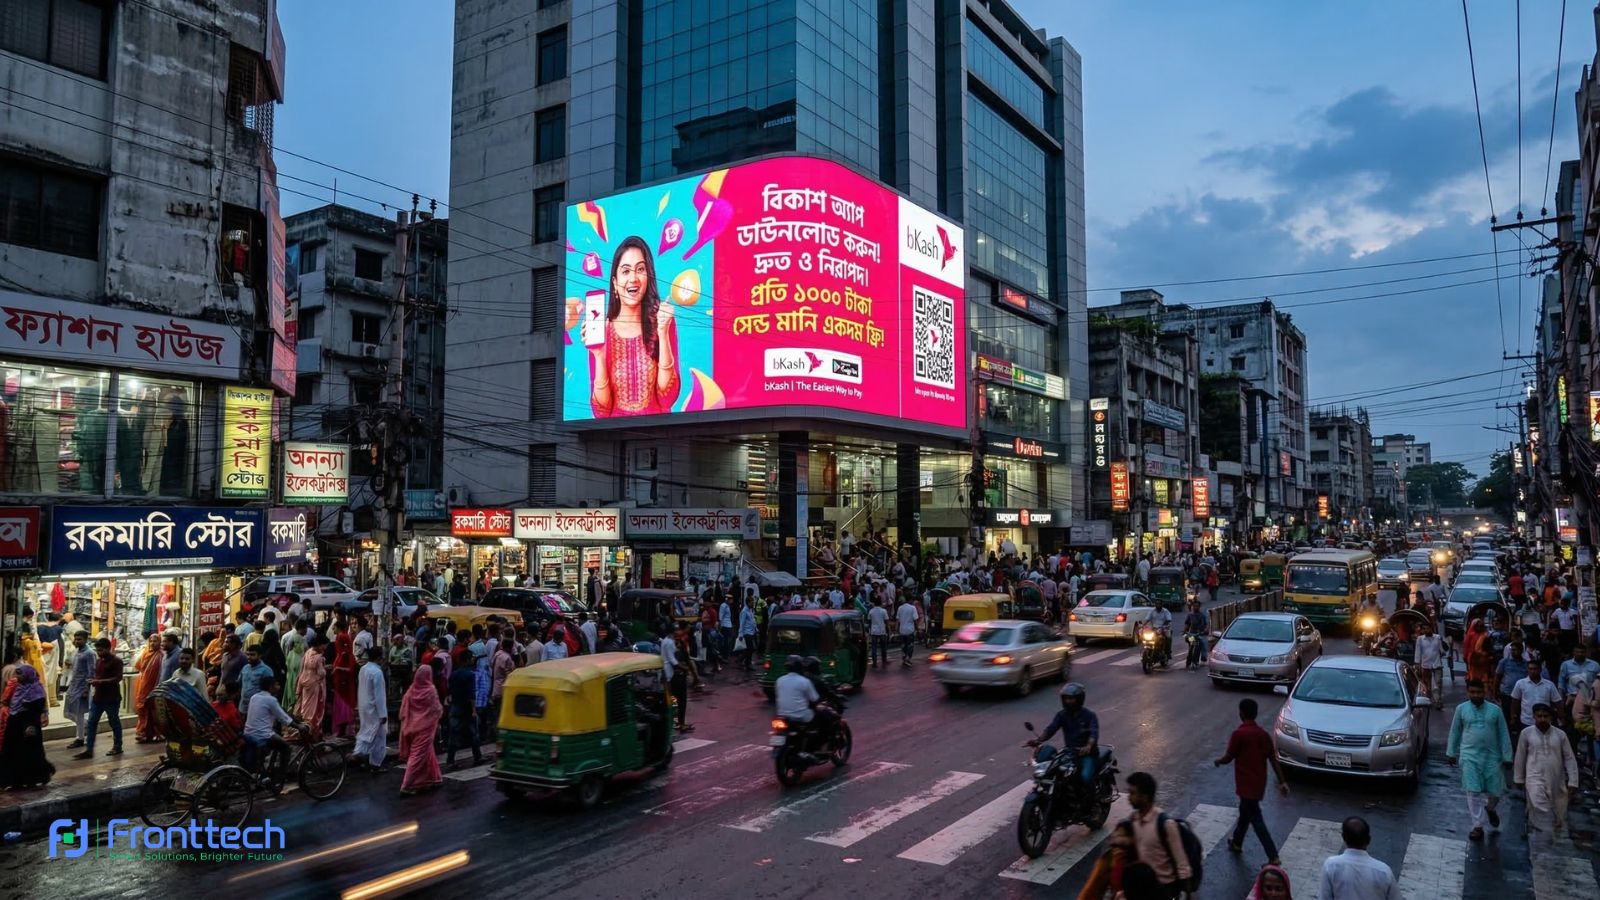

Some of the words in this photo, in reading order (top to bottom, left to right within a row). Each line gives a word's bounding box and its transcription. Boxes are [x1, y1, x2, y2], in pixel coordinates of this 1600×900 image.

[762, 184, 828, 213] বিকাশ
[830, 196, 865, 229] অ্যাপ
[737, 217, 841, 247] ডাউনলোড
[843, 230, 881, 264] করুন!
[906, 225, 939, 260] bKash
[753, 251, 792, 275] দ্রুত
[798, 252, 813, 272] ও
[750, 277, 789, 306] প্রতি
[793, 284, 841, 306] ১০০০
[844, 287, 873, 317] টাকা
[1, 307, 124, 354] ফ্যাশন
[133, 320, 225, 365] হাউজ
[732, 314, 770, 336] সেন্ড
[775, 308, 818, 333] মানি
[822, 315, 865, 343] একদম
[865, 319, 885, 349] ফ্রি!
[773, 357, 805, 370] bKash
[764, 382, 790, 392] bKash
[796, 382, 813, 392] The
[854, 389, 864, 400] Pay
[287, 449, 346, 470] অনন্যা
[285, 470, 347, 494] ইলেকট্রনিক্স
[63, 511, 176, 552] রকমারি
[185, 512, 255, 549] স্টোর
[270, 513, 307, 545] রকমারি
[454, 510, 487, 529] রকমারি
[488, 511, 511, 530] স্টোর
[518, 514, 552, 531] অনন্যা
[556, 510, 617, 533] ইলেকট্রনিক্স
[628, 513, 668, 532] অনন্যা
[672, 509, 743, 533] ইলেকট্রনিক্স
